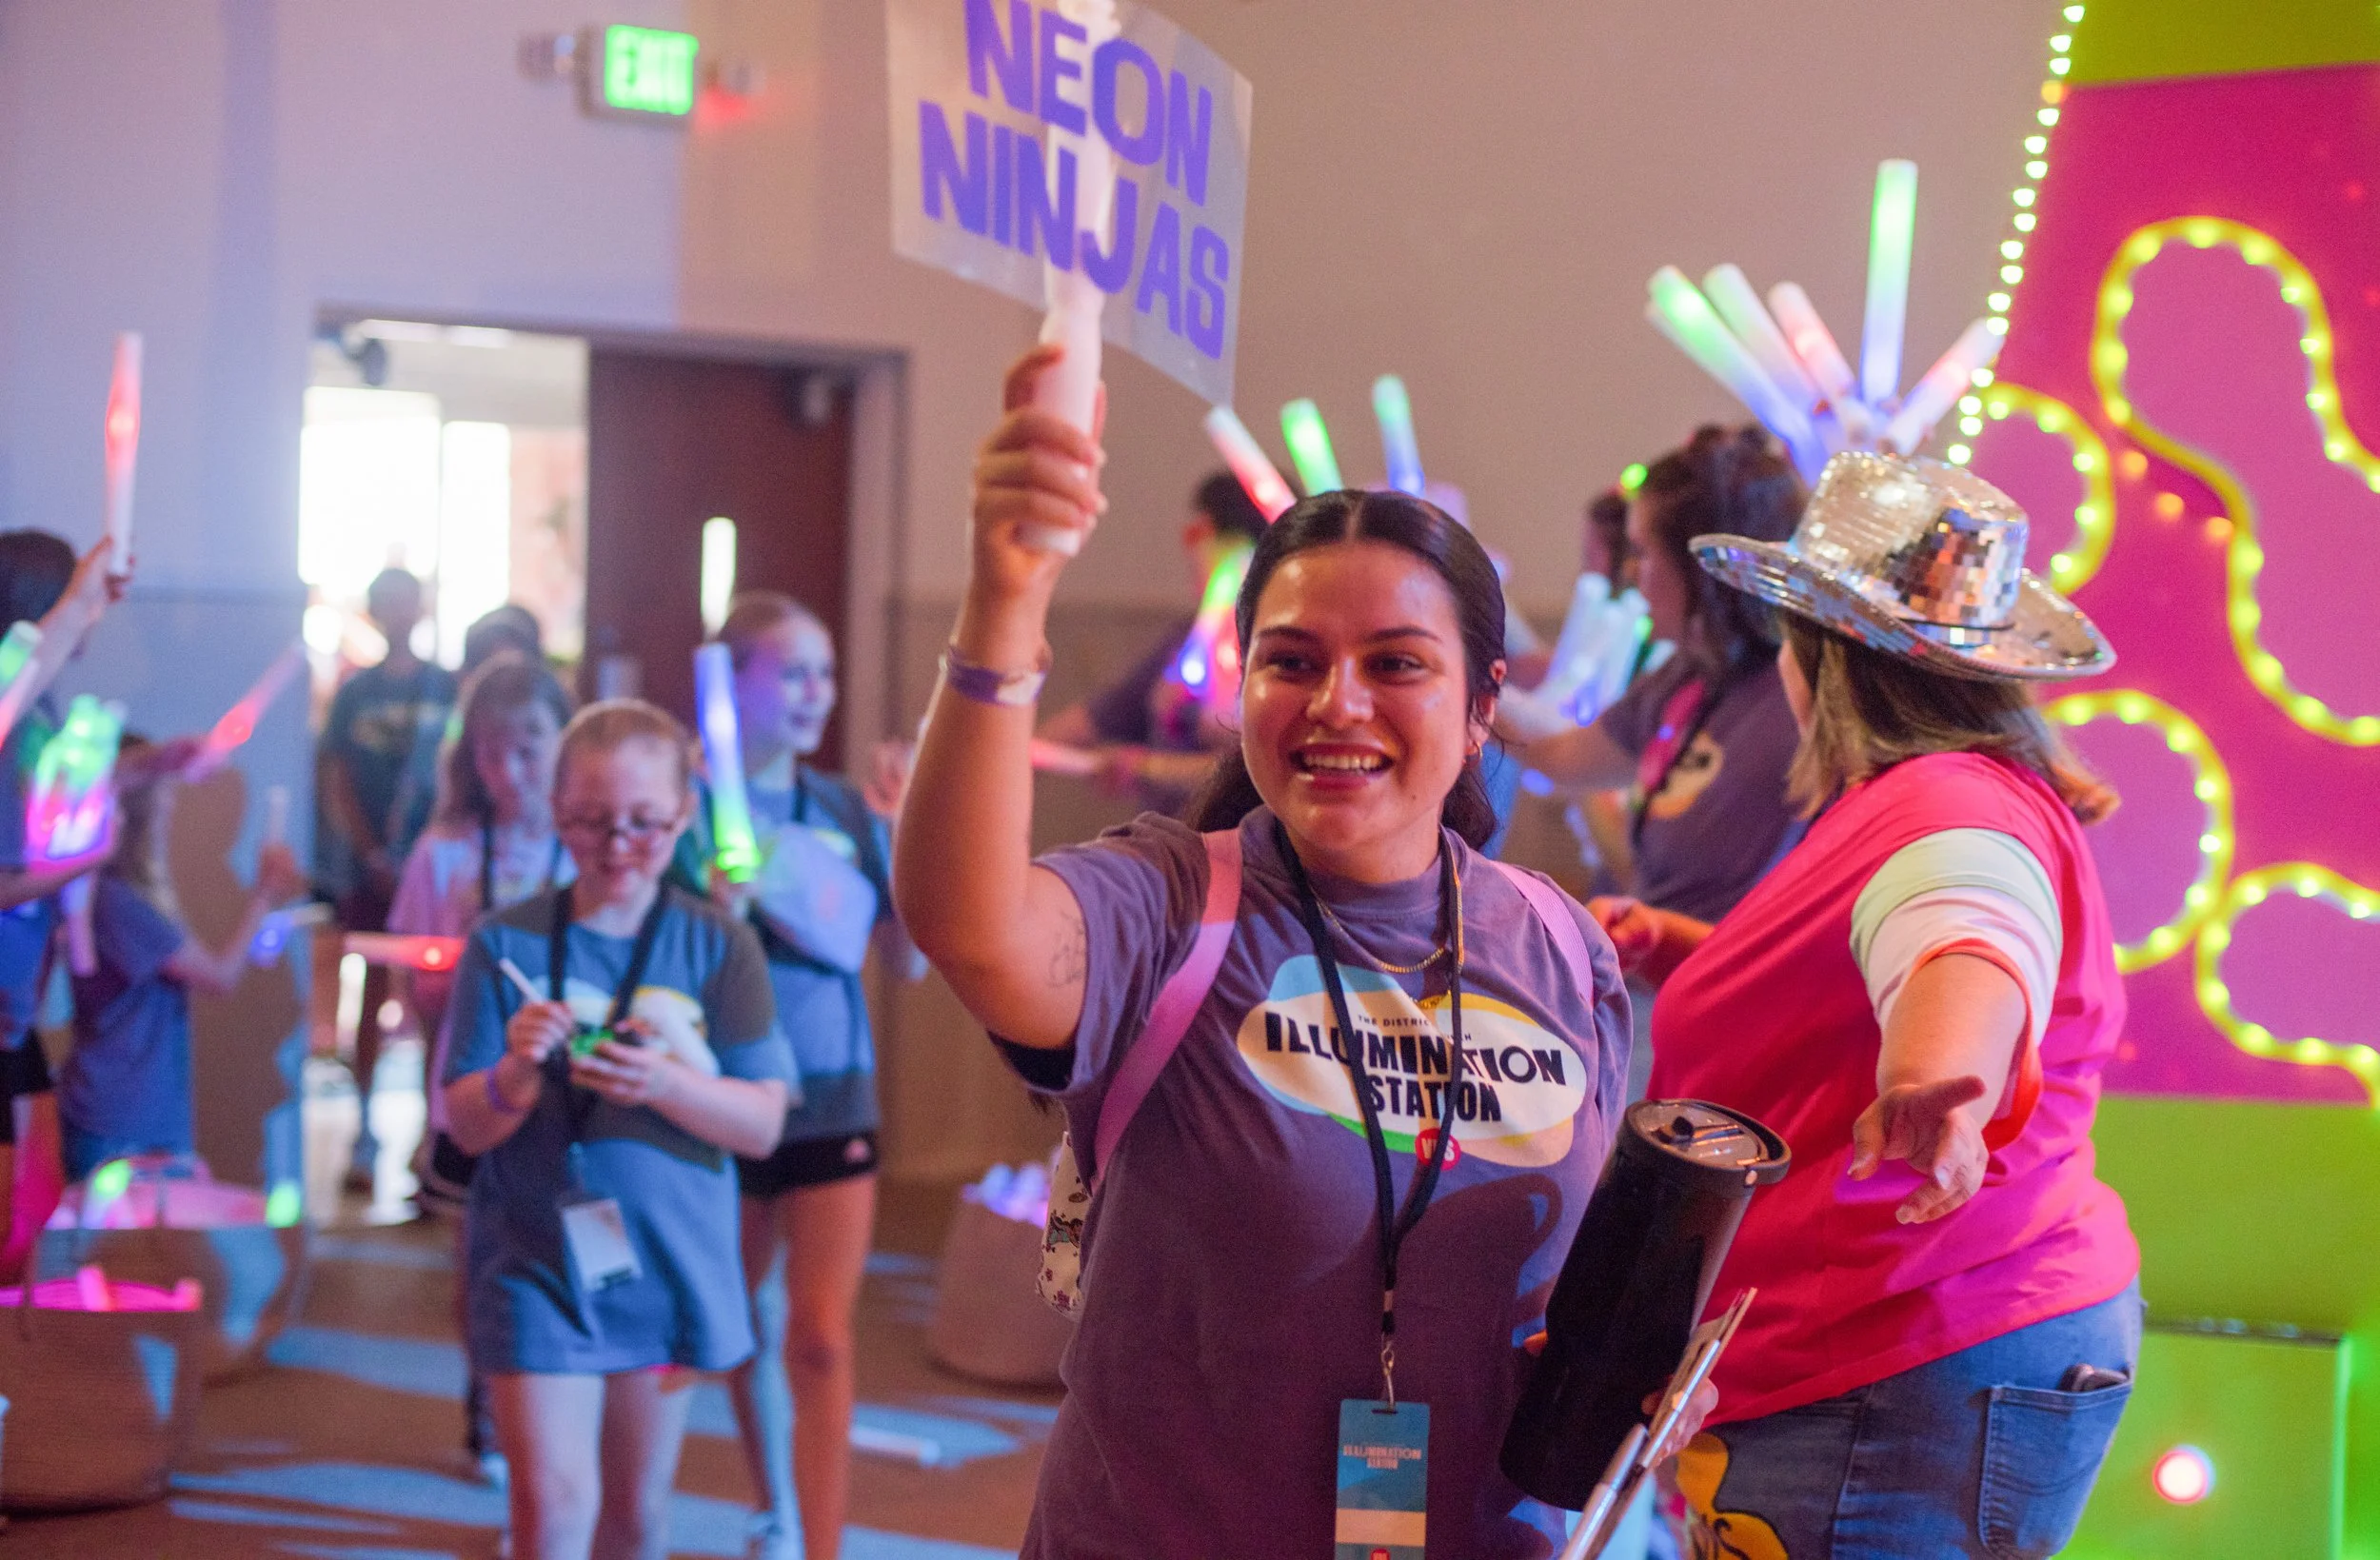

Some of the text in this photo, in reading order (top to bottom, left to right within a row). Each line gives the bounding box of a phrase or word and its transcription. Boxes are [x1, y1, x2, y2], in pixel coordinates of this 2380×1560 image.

[607, 28, 693, 109] EXIT
[962, 0, 1212, 207] NEON
[919, 99, 1230, 360] NINJAS
[1382, 1018, 1430, 1027] DISTRIC
